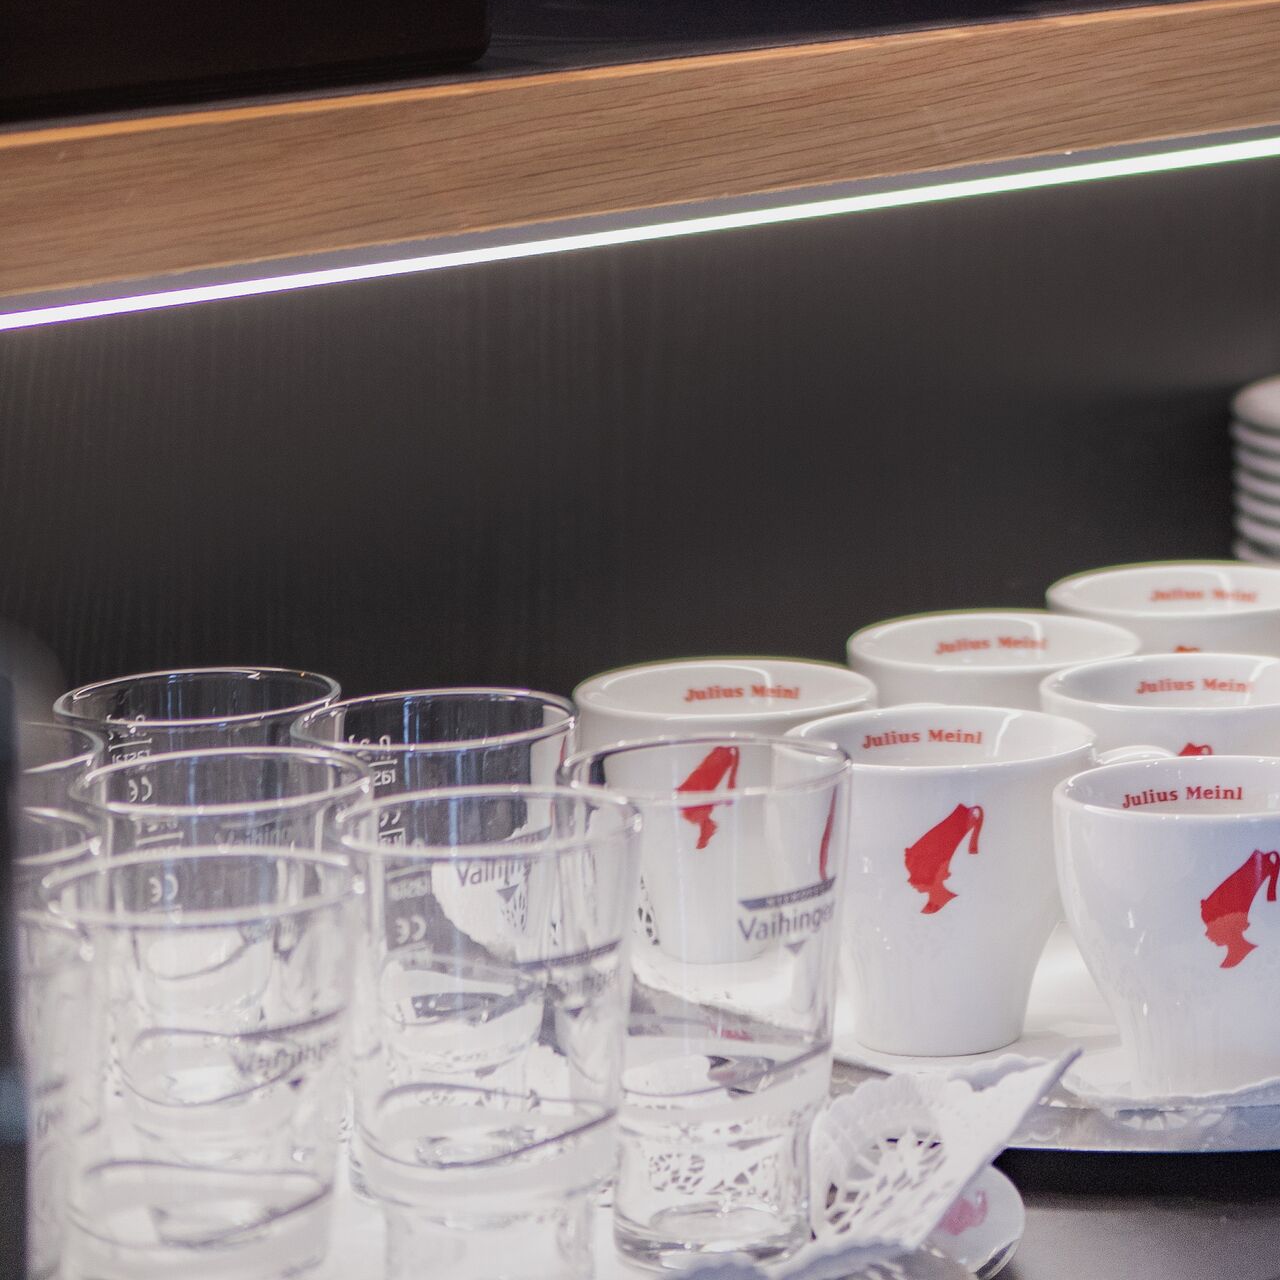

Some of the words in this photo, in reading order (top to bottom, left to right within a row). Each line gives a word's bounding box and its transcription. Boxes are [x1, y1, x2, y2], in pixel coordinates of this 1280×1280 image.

[684, 684, 745, 703] Julius
[1136, 678, 1195, 695] Julius
[862, 731, 922, 750] Julius
[927, 728, 983, 745] Meinl
[1122, 788, 1180, 810] Julius
[1185, 784, 1244, 802] Meinl
